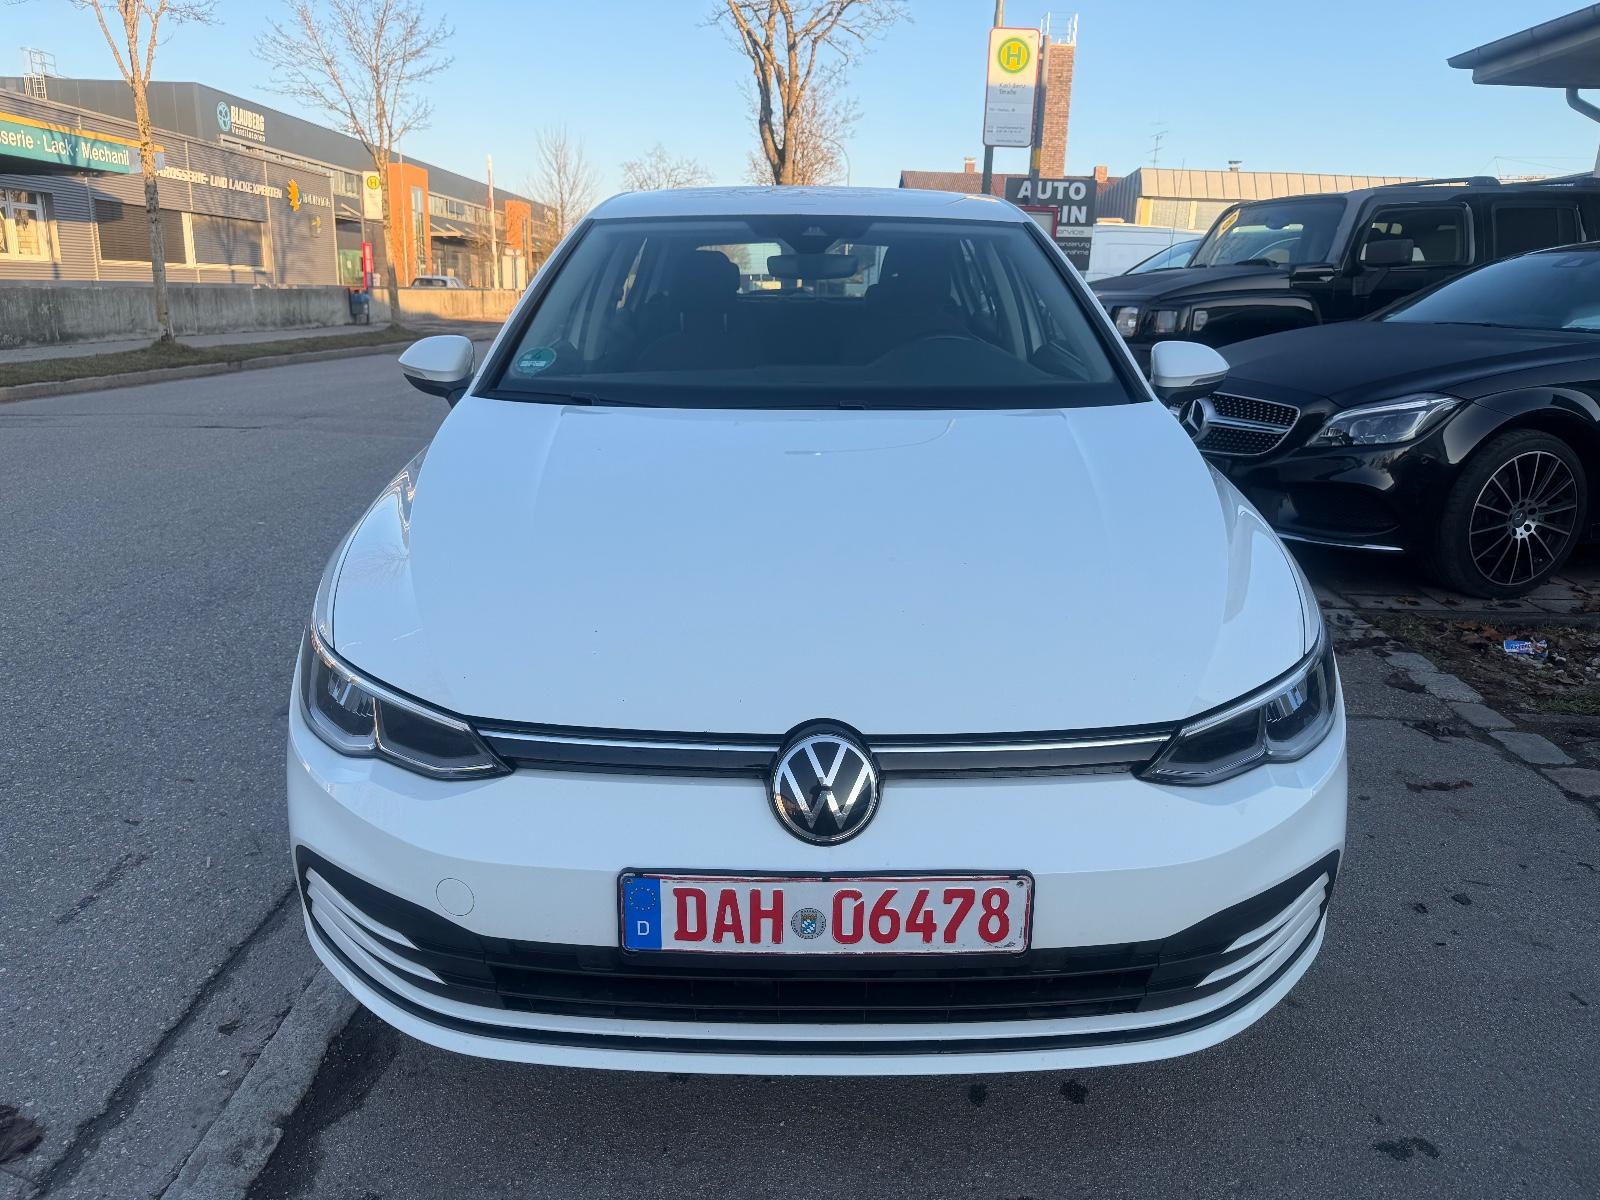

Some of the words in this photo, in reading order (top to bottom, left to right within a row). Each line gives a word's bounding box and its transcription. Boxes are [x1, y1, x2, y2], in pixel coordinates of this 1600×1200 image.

[1005, 46, 1022, 65] H
[230, 105, 265, 132] BLAUBERG
[0, 129, 34, 149] serie
[43, 134, 74, 156] Lack
[1016, 180, 1087, 201] AUTO
[1056, 204, 1087, 224] IN
[1057, 228, 1085, 236] ervice
[672, 887, 784, 944] DAH
[831, 887, 1011, 945] 06478
[637, 921, 650, 936] D
